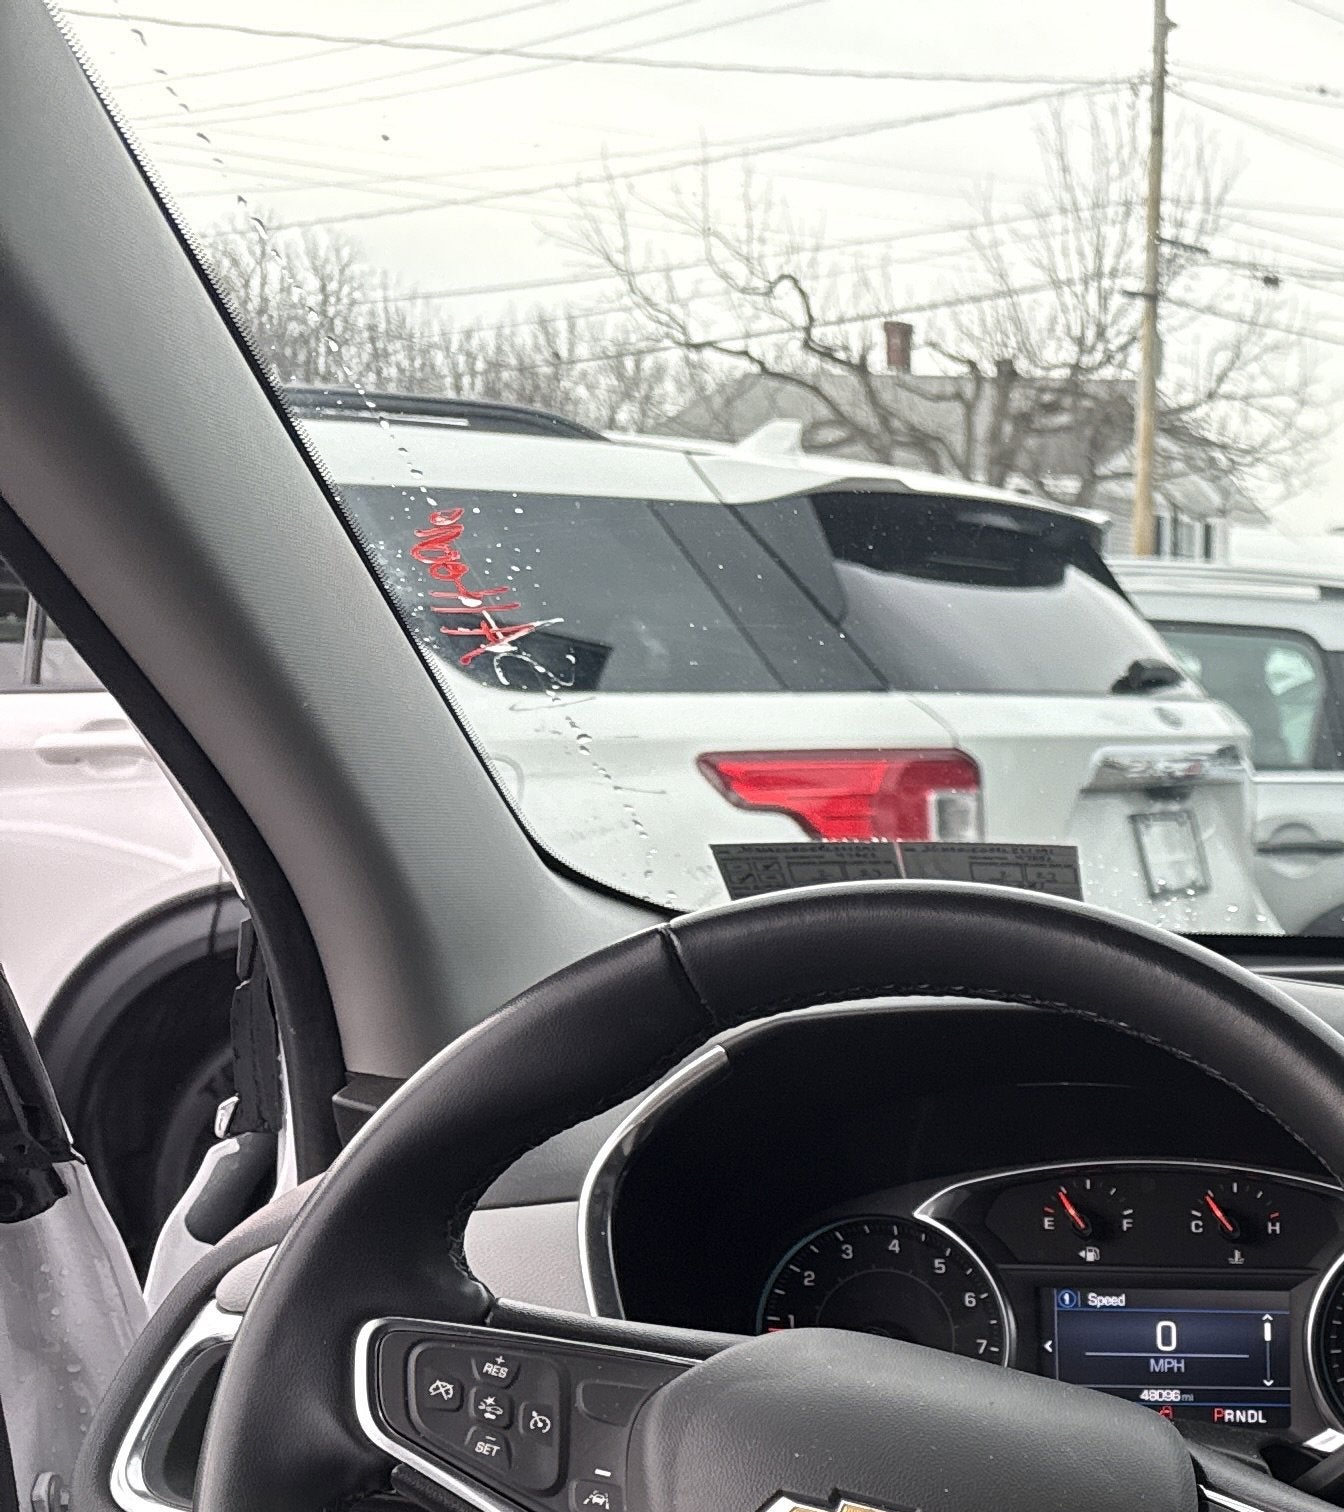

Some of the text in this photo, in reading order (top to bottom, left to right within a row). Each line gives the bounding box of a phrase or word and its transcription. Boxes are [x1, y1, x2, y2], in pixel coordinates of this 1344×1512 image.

[1044, 1218, 1054, 1229] E
[1123, 1219, 1132, 1231] F
[1191, 1221, 1202, 1232] C
[1268, 1222, 1280, 1234] H
[842, 1245, 853, 1259] 3
[889, 1239, 900, 1253] 4
[935, 1259, 946, 1273] 5
[803, 1271, 815, 1285] 2
[965, 1292, 976, 1307] 6
[1088, 1293, 1125, 1308] Speed
[1156, 1321, 1177, 1351] 0
[977, 1340, 988, 1353] 7
[483, 1362, 508, 1379] RES
[1149, 1358, 1186, 1373] MPH
[475, 1441, 500, 1456] SET
